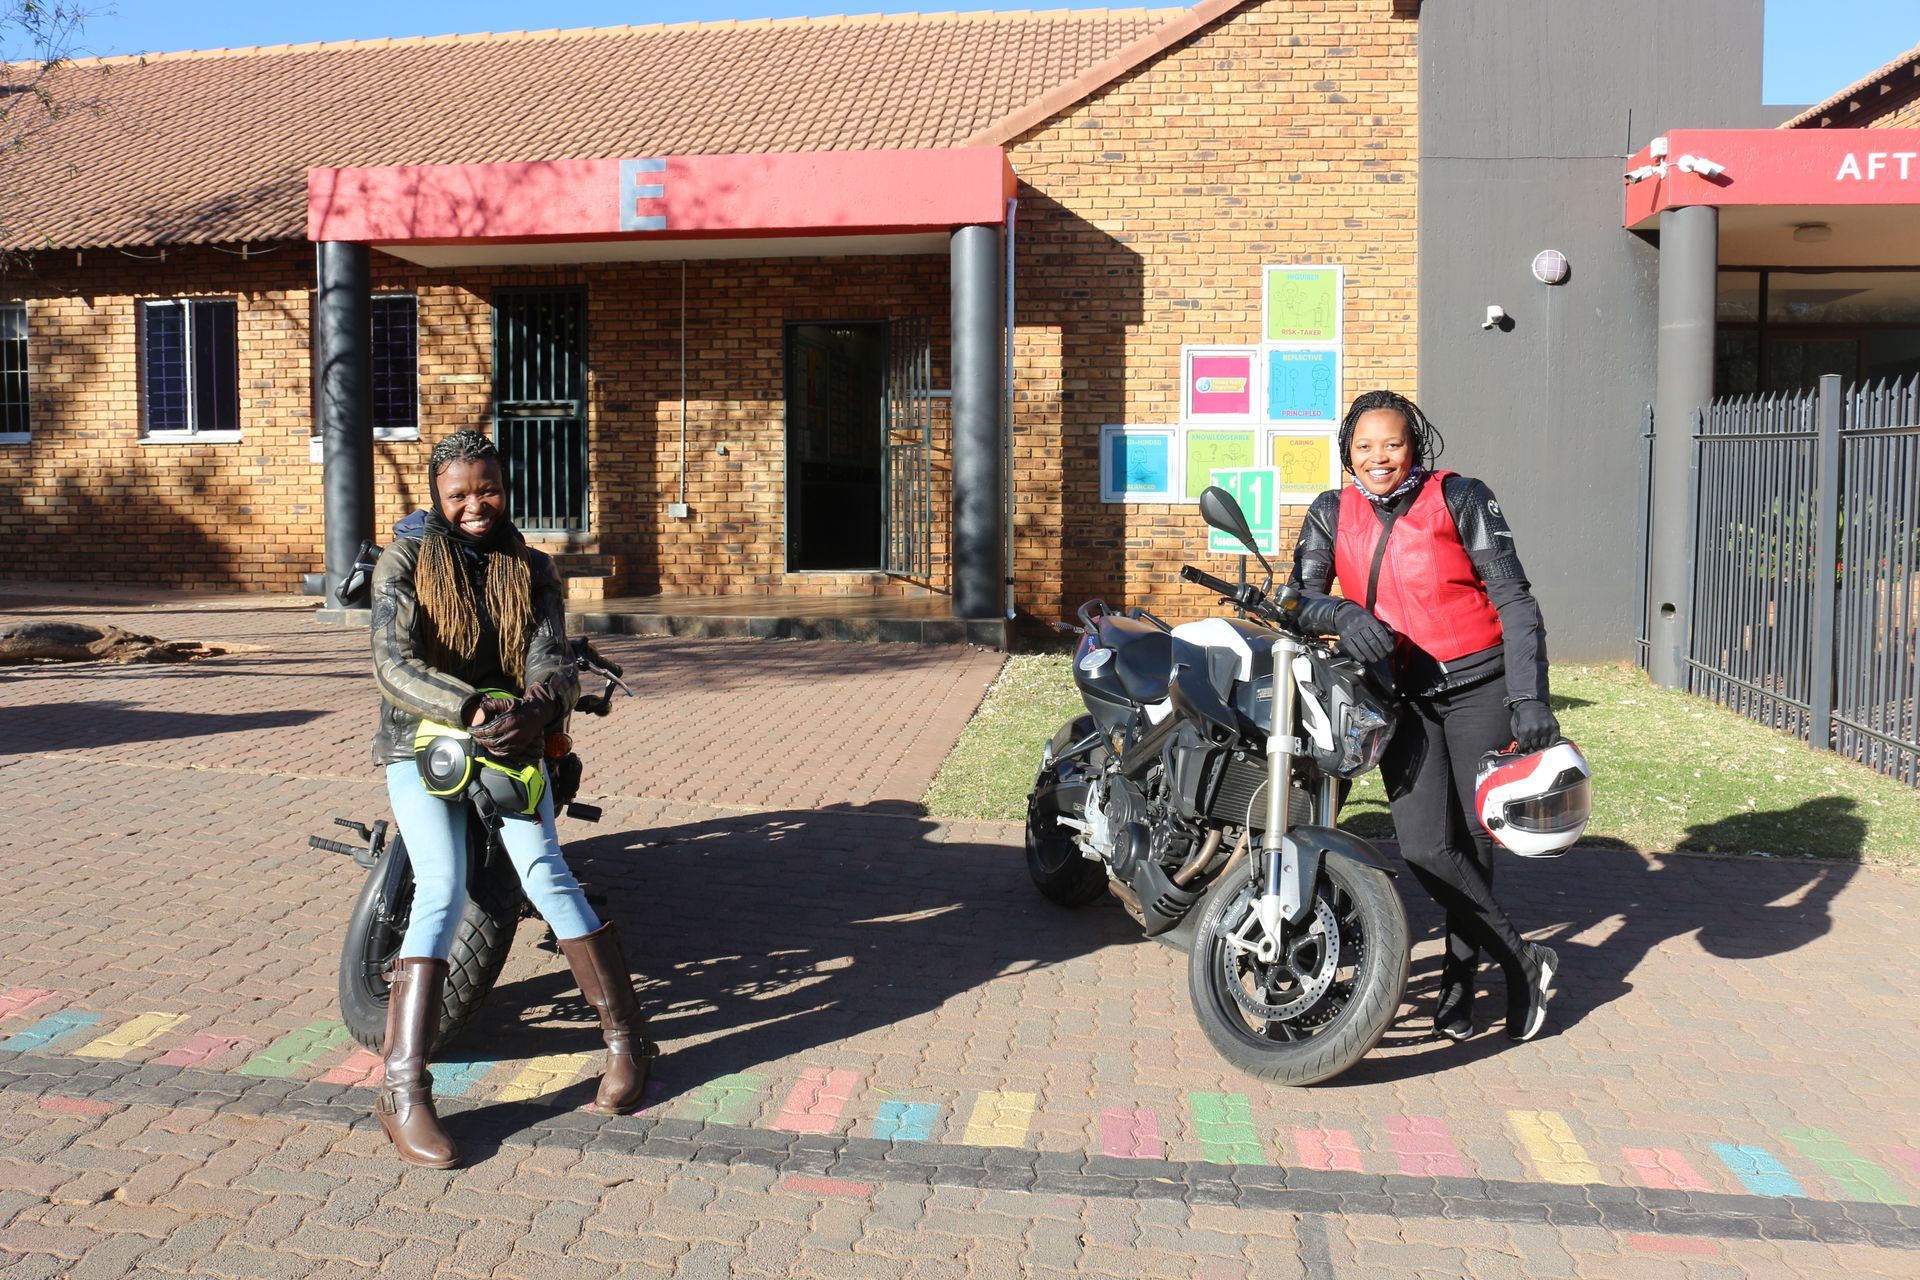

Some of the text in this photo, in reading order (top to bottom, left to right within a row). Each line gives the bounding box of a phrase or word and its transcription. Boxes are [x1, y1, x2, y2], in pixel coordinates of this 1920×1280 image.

[1836, 153, 1917, 181] AFT
[620, 158, 666, 231] E
[1281, 328, 1322, 336] RISK-TAKER
[1283, 353, 1323, 361] REFLECTIVE
[1281, 409, 1322, 417] PRINCIPLED
[1249, 476, 1262, 525] 1
[1196, 897, 1220, 951] METZELER
[1223, 901, 1243, 926] brembo
